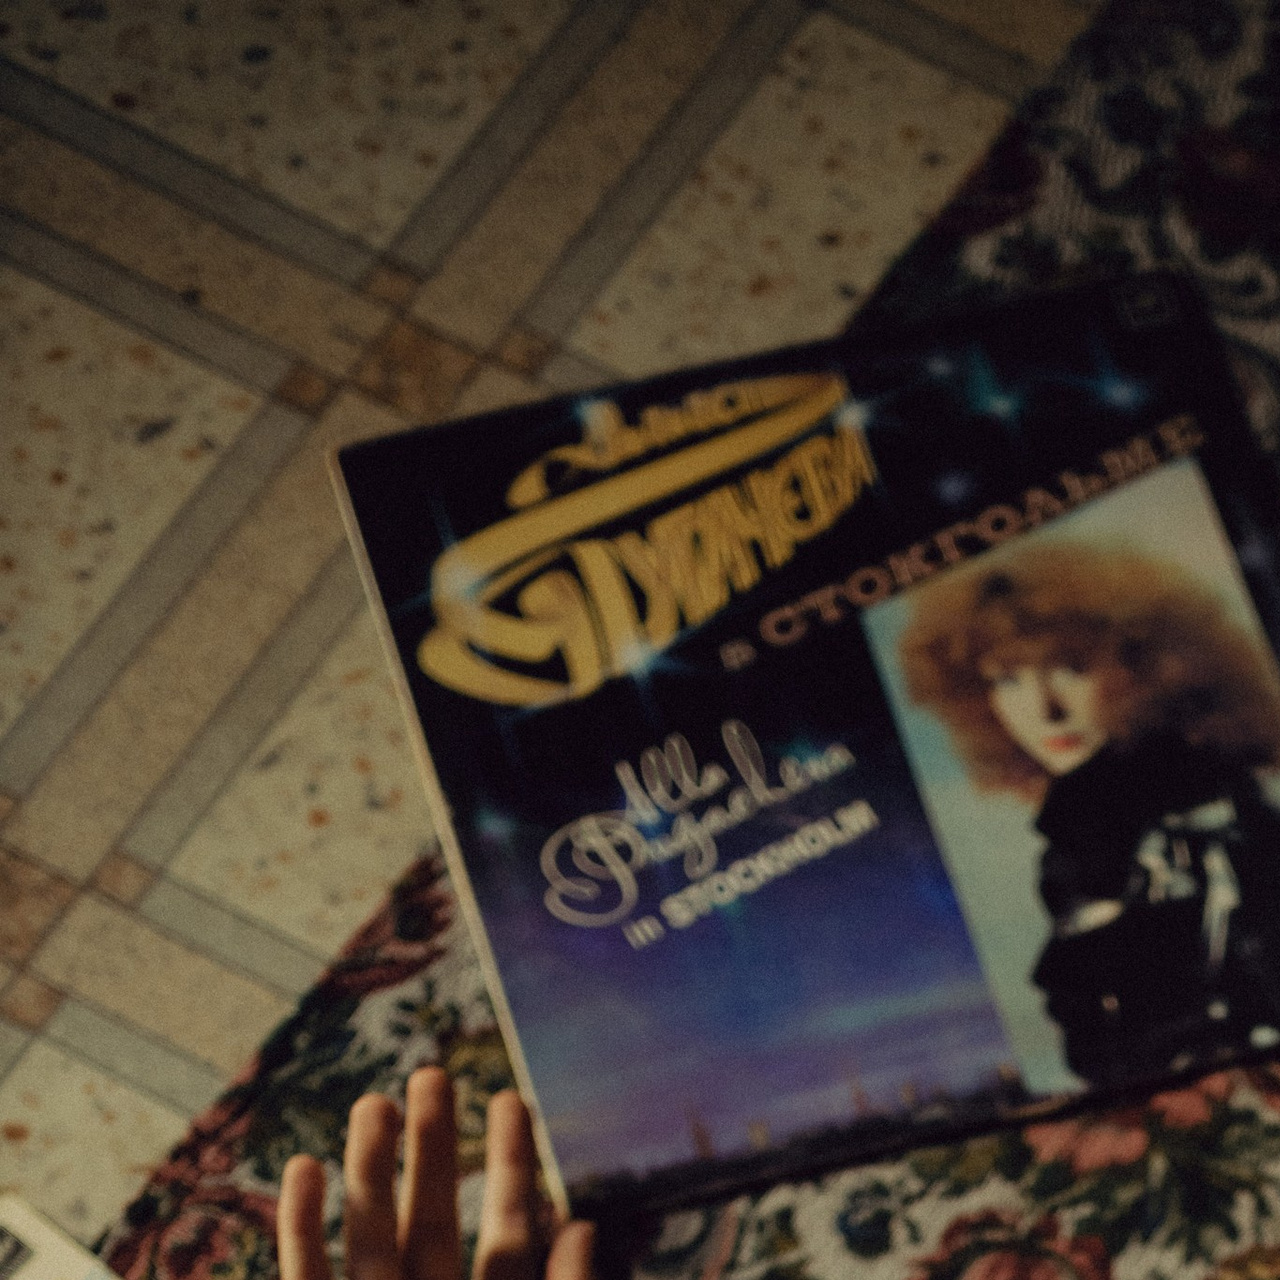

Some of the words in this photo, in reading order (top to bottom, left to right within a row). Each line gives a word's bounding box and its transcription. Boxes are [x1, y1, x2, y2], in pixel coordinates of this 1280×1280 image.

[755, 414, 1201, 649] СТОКГОЛЬМЕ
[620, 911, 666, 951] in
[655, 799, 880, 924] STOCKHOLM
